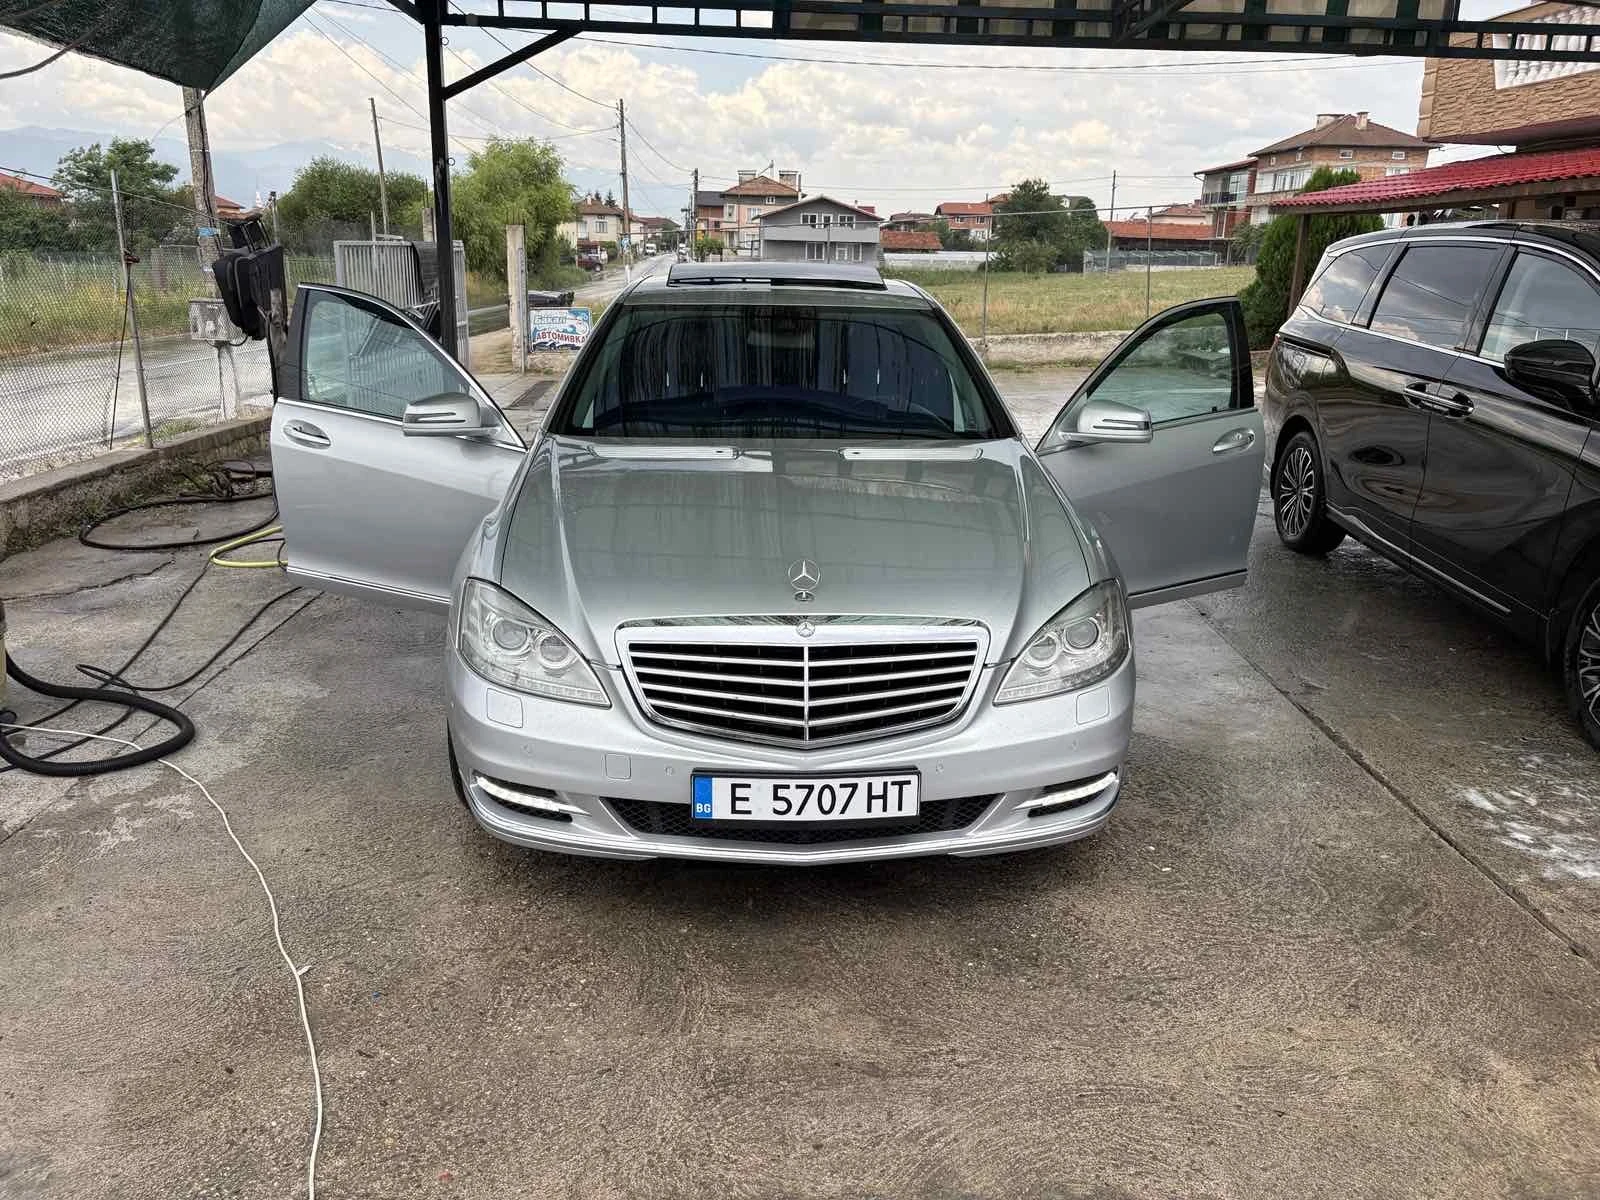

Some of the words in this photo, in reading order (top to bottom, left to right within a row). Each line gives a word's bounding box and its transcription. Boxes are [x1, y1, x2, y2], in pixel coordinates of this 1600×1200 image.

[536, 331, 586, 344] АВТОМИВКА
[730, 783, 752, 815] E
[772, 782, 859, 816] 5707
[866, 780, 912, 813] HT
[695, 803, 712, 814] BG
